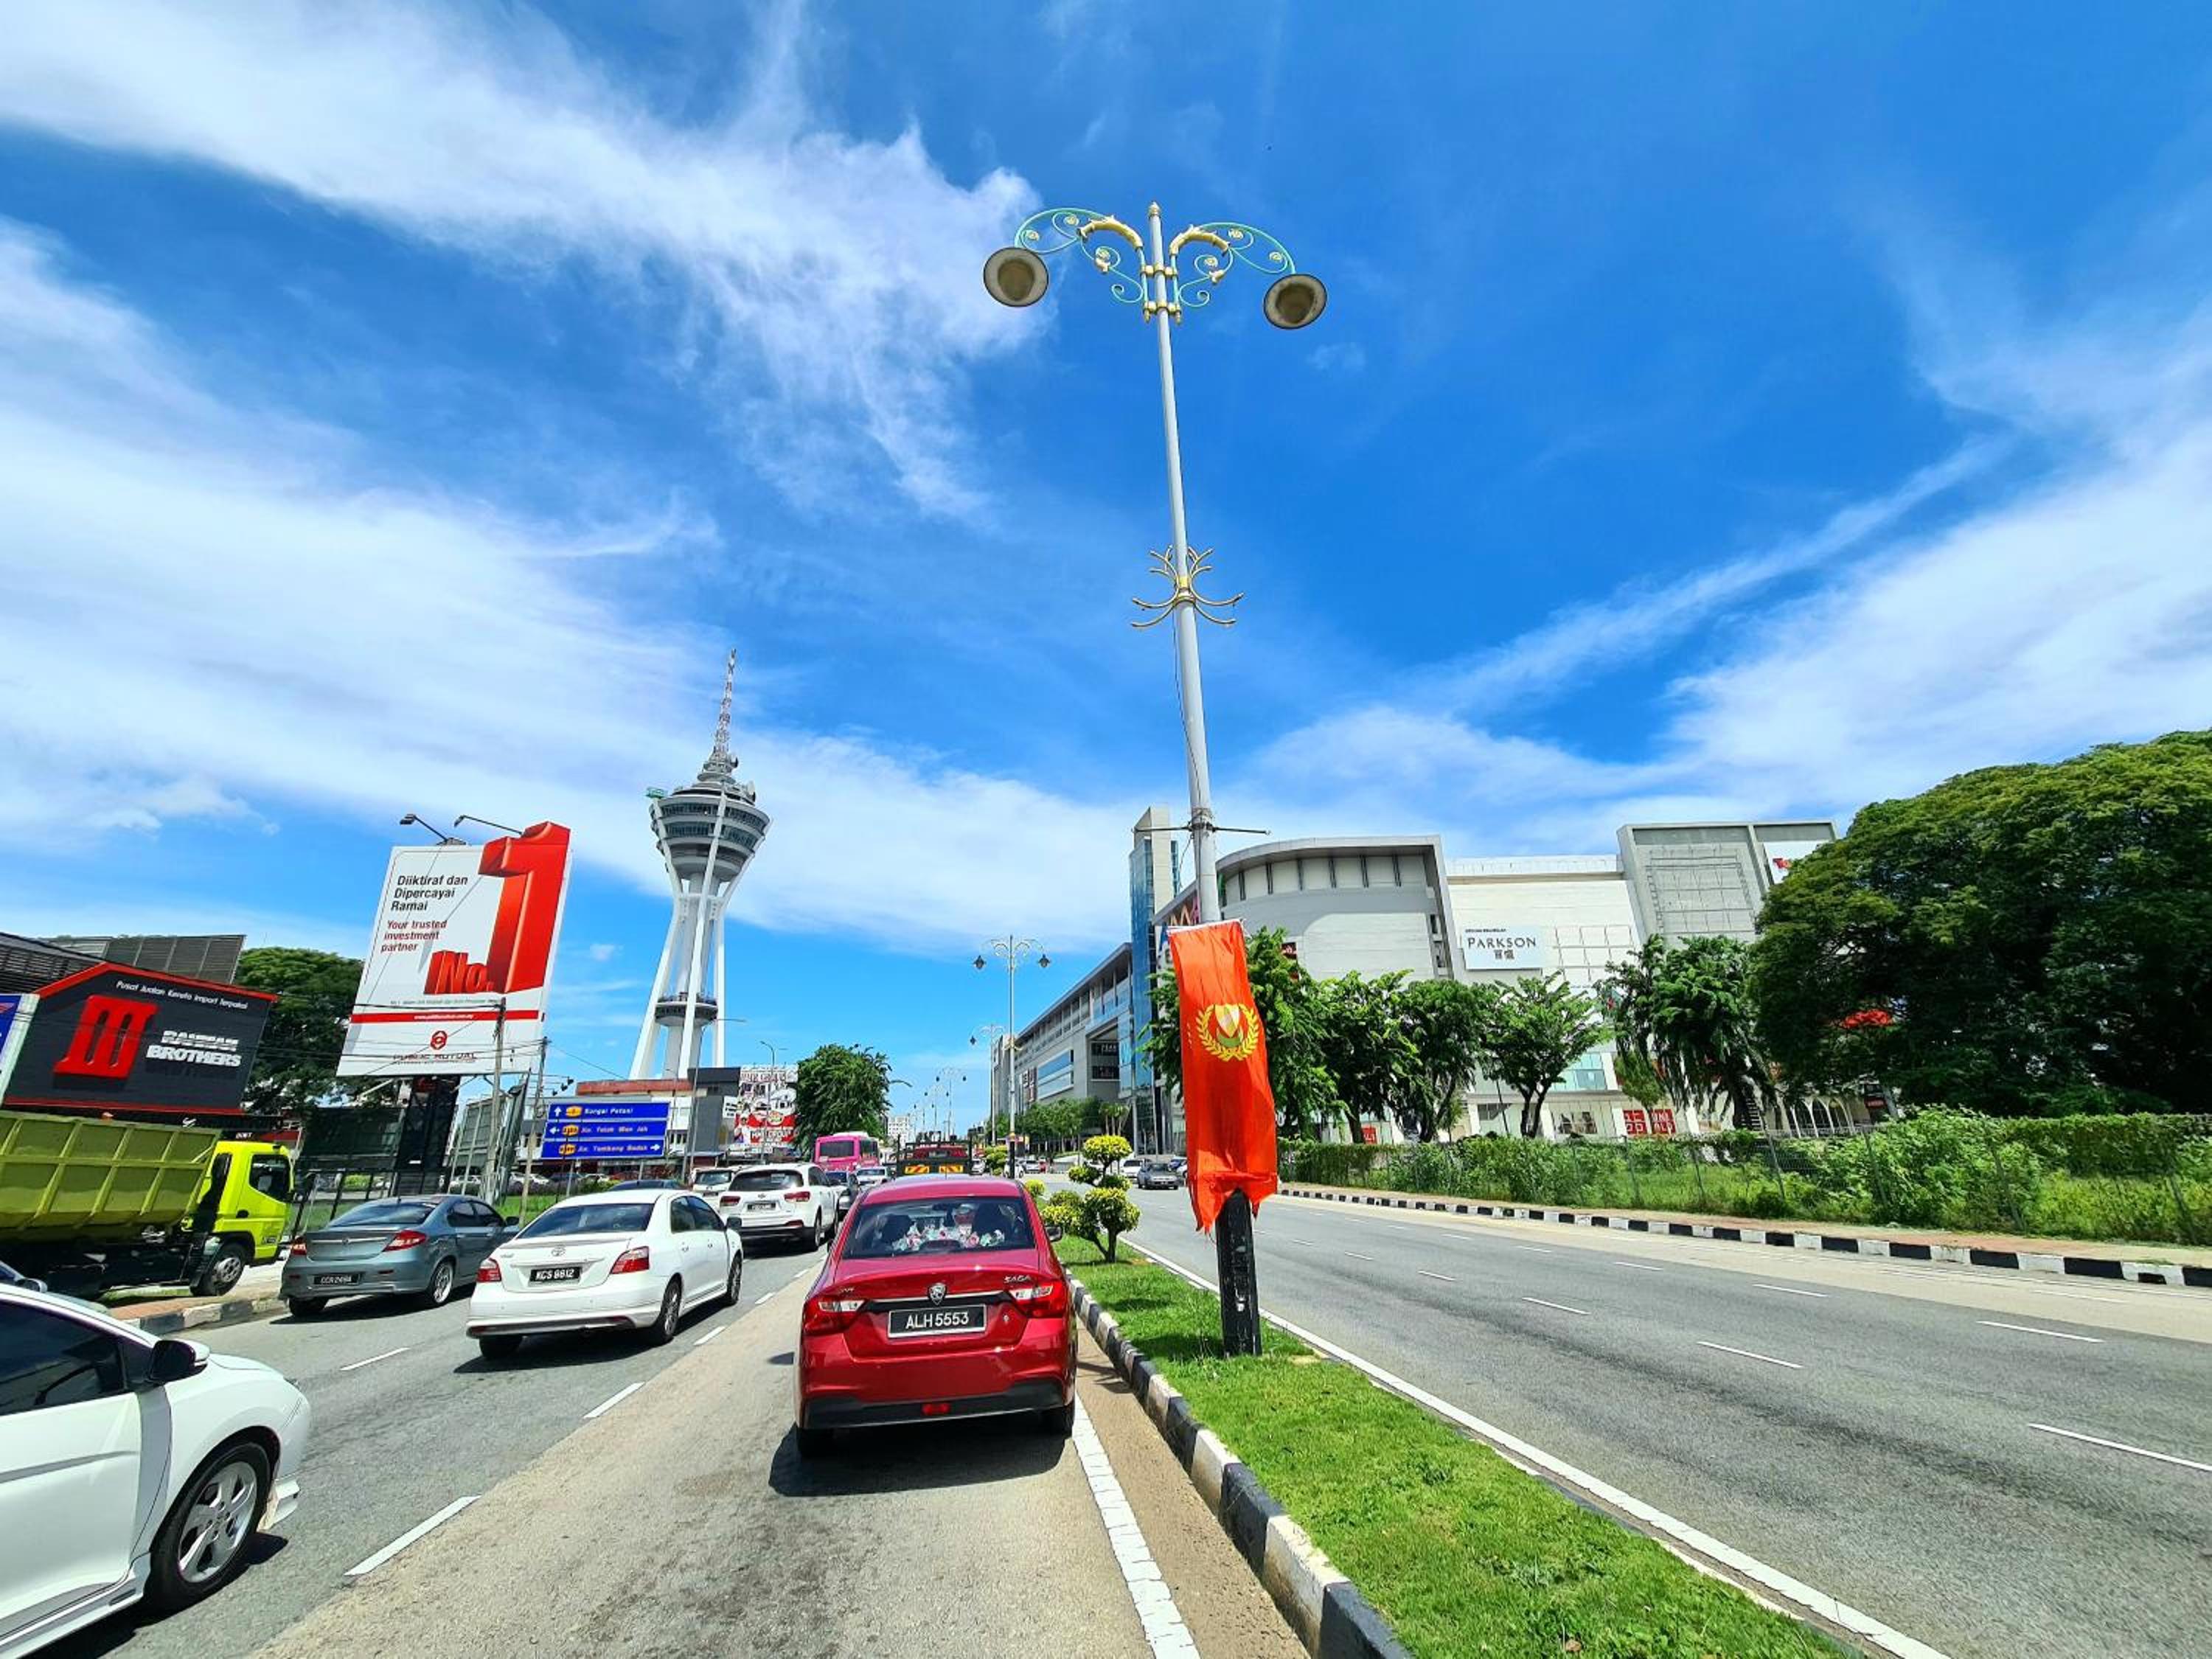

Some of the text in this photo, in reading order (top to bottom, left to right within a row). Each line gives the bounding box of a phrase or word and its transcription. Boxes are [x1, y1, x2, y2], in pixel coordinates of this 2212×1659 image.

[397, 874, 468, 886] Diiktiraf dan
[394, 887, 455, 900] Dipercayai
[391, 900, 428, 911] Ramai
[387, 920, 447, 930] Your trusted
[384, 932, 439, 940] investment
[380, 943, 419, 953] partner
[1467, 937, 1537, 949] PARKSON
[146, 1045, 242, 1067] BROTHERS
[1004, 1275, 1032, 1284] SAGA
